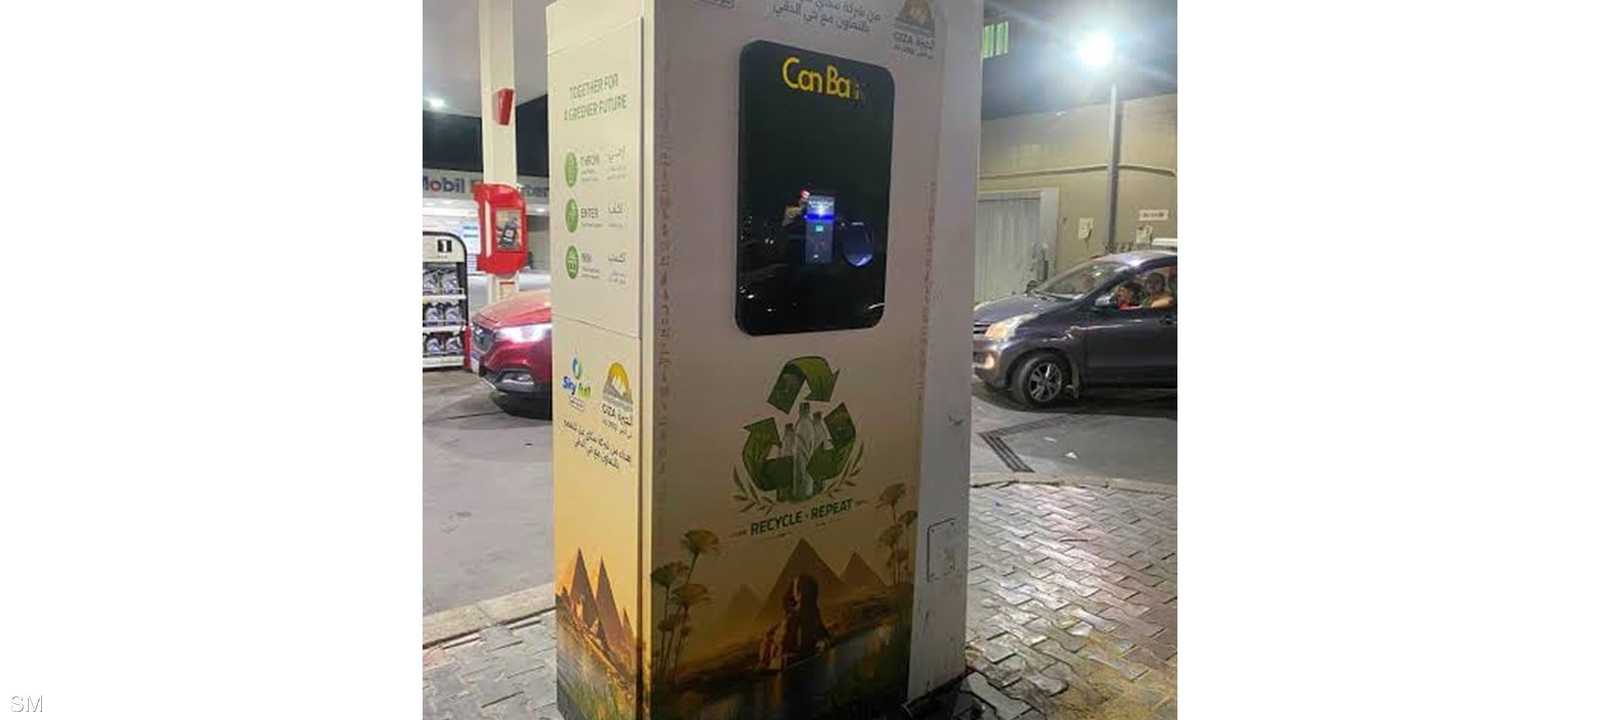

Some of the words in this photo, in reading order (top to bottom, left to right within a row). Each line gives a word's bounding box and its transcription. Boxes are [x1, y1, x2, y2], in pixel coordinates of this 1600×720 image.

[569, 77, 603, 99] TOGETHER
[604, 73, 619, 91] FOR
[782, 56, 822, 93] Can
[569, 101, 599, 121] GREENER
[600, 94, 627, 115] FUTURE
[750, 510, 803, 537] RECYCLE
[810, 498, 854, 521] REPEAT
